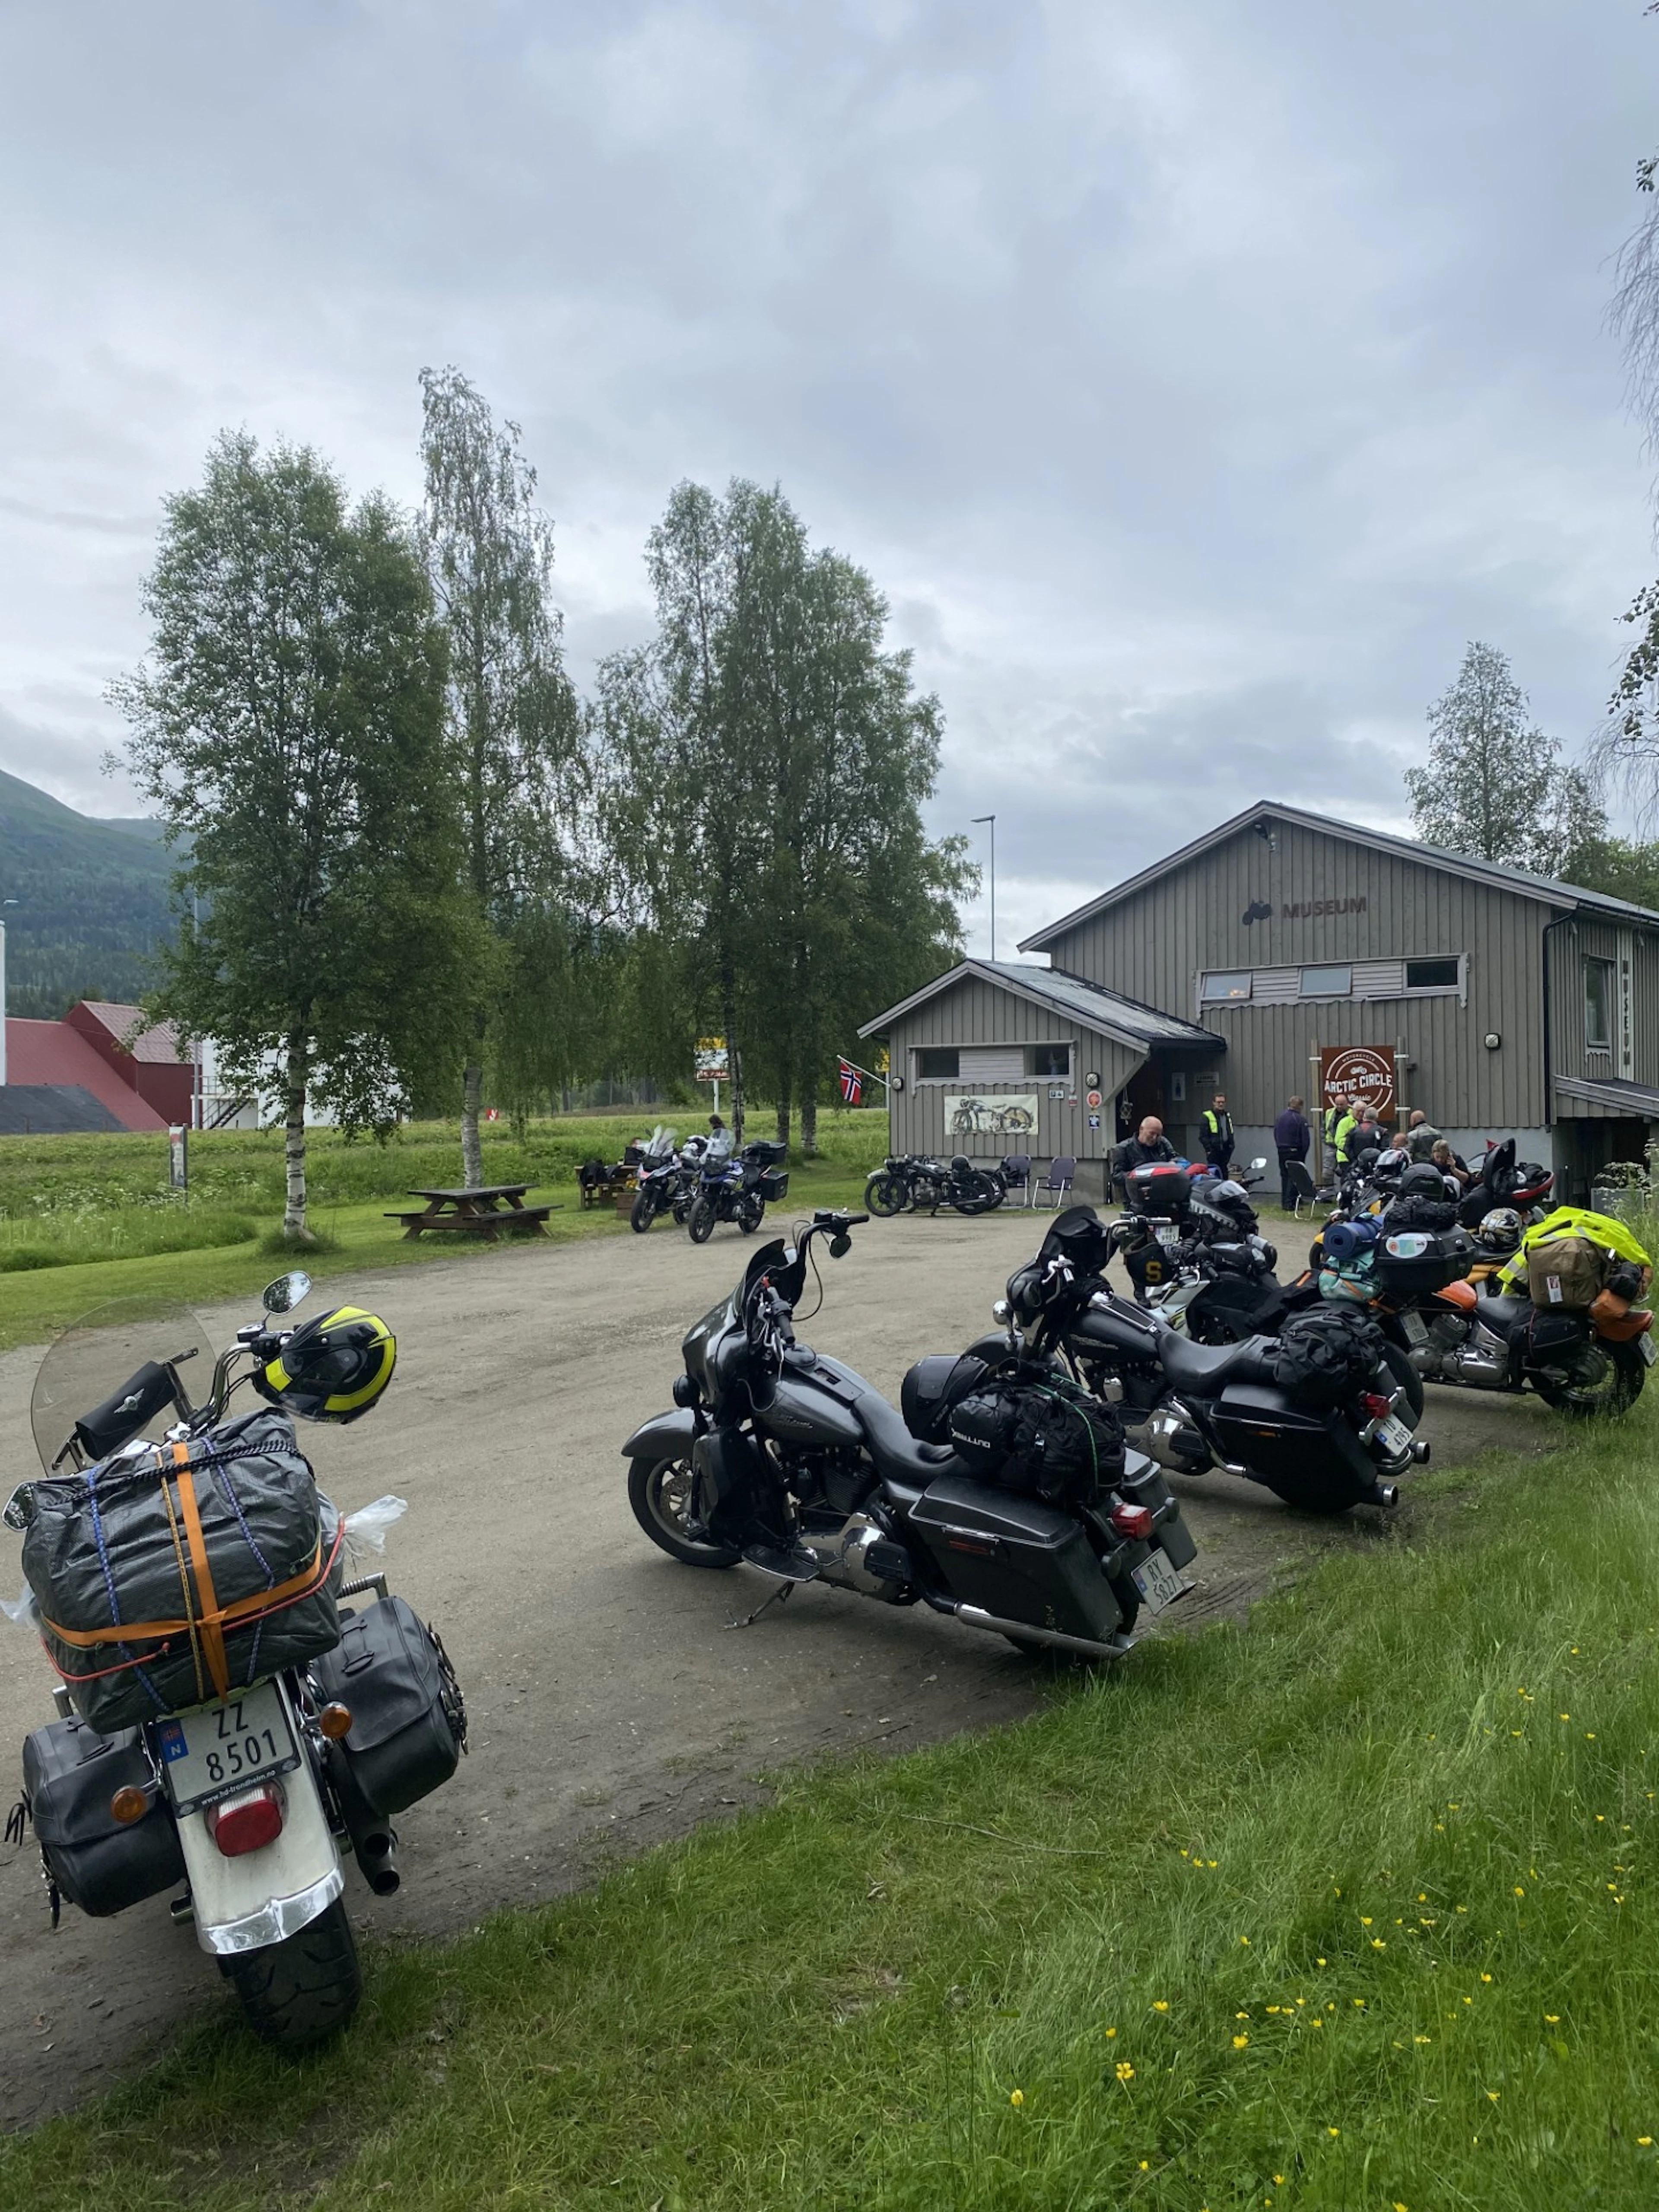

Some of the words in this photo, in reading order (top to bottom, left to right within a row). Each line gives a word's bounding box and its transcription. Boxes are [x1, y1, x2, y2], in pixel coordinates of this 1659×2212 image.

[1283, 896, 1366, 918] MUSEUM
[1324, 1078, 1357, 1093] ARCTIC
[1359, 1073, 1393, 1088] CIRCLE
[1145, 1261, 1162, 1282] S
[1394, 1427, 1410, 1446] 4795
[1147, 1558, 1163, 1581] RY
[1153, 1574, 1177, 1604] 5827
[212, 1700, 249, 1739] ZZ
[170, 1745, 182, 1756] N
[206, 1729, 277, 1782] 8501
[201, 1770, 276, 1805] www.hd-trondheim.no
